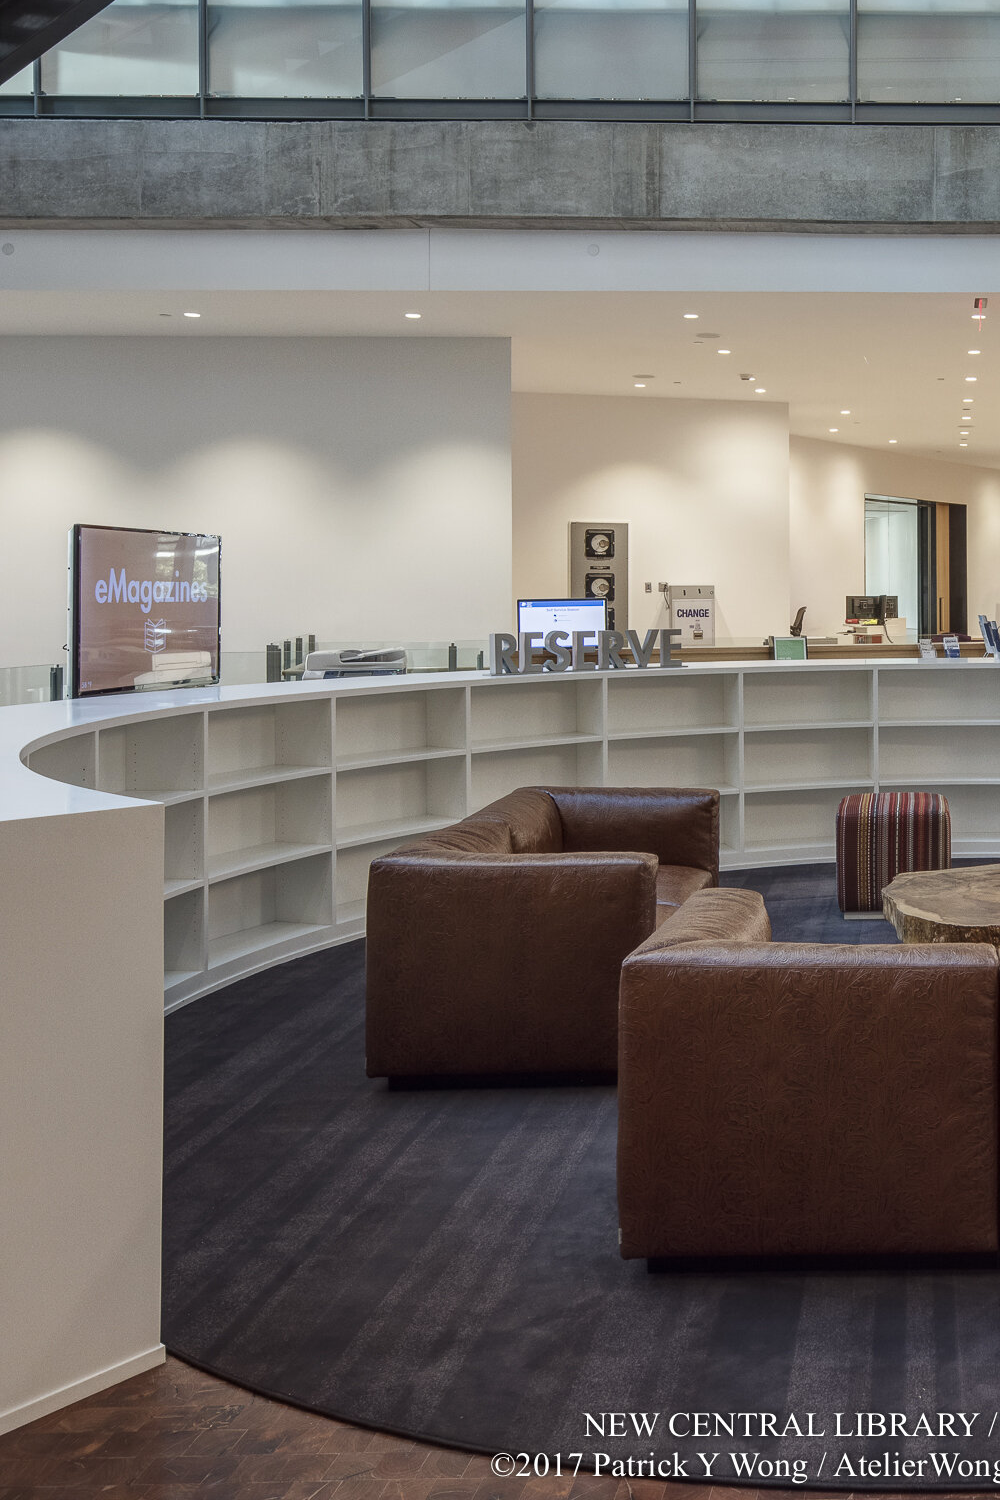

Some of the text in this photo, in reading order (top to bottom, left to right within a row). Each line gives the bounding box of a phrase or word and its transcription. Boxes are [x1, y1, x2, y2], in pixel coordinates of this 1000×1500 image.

[94, 567, 208, 614] eMagazines
[677, 608, 710, 618] CHANGE
[489, 629, 682, 676] RESERVE
